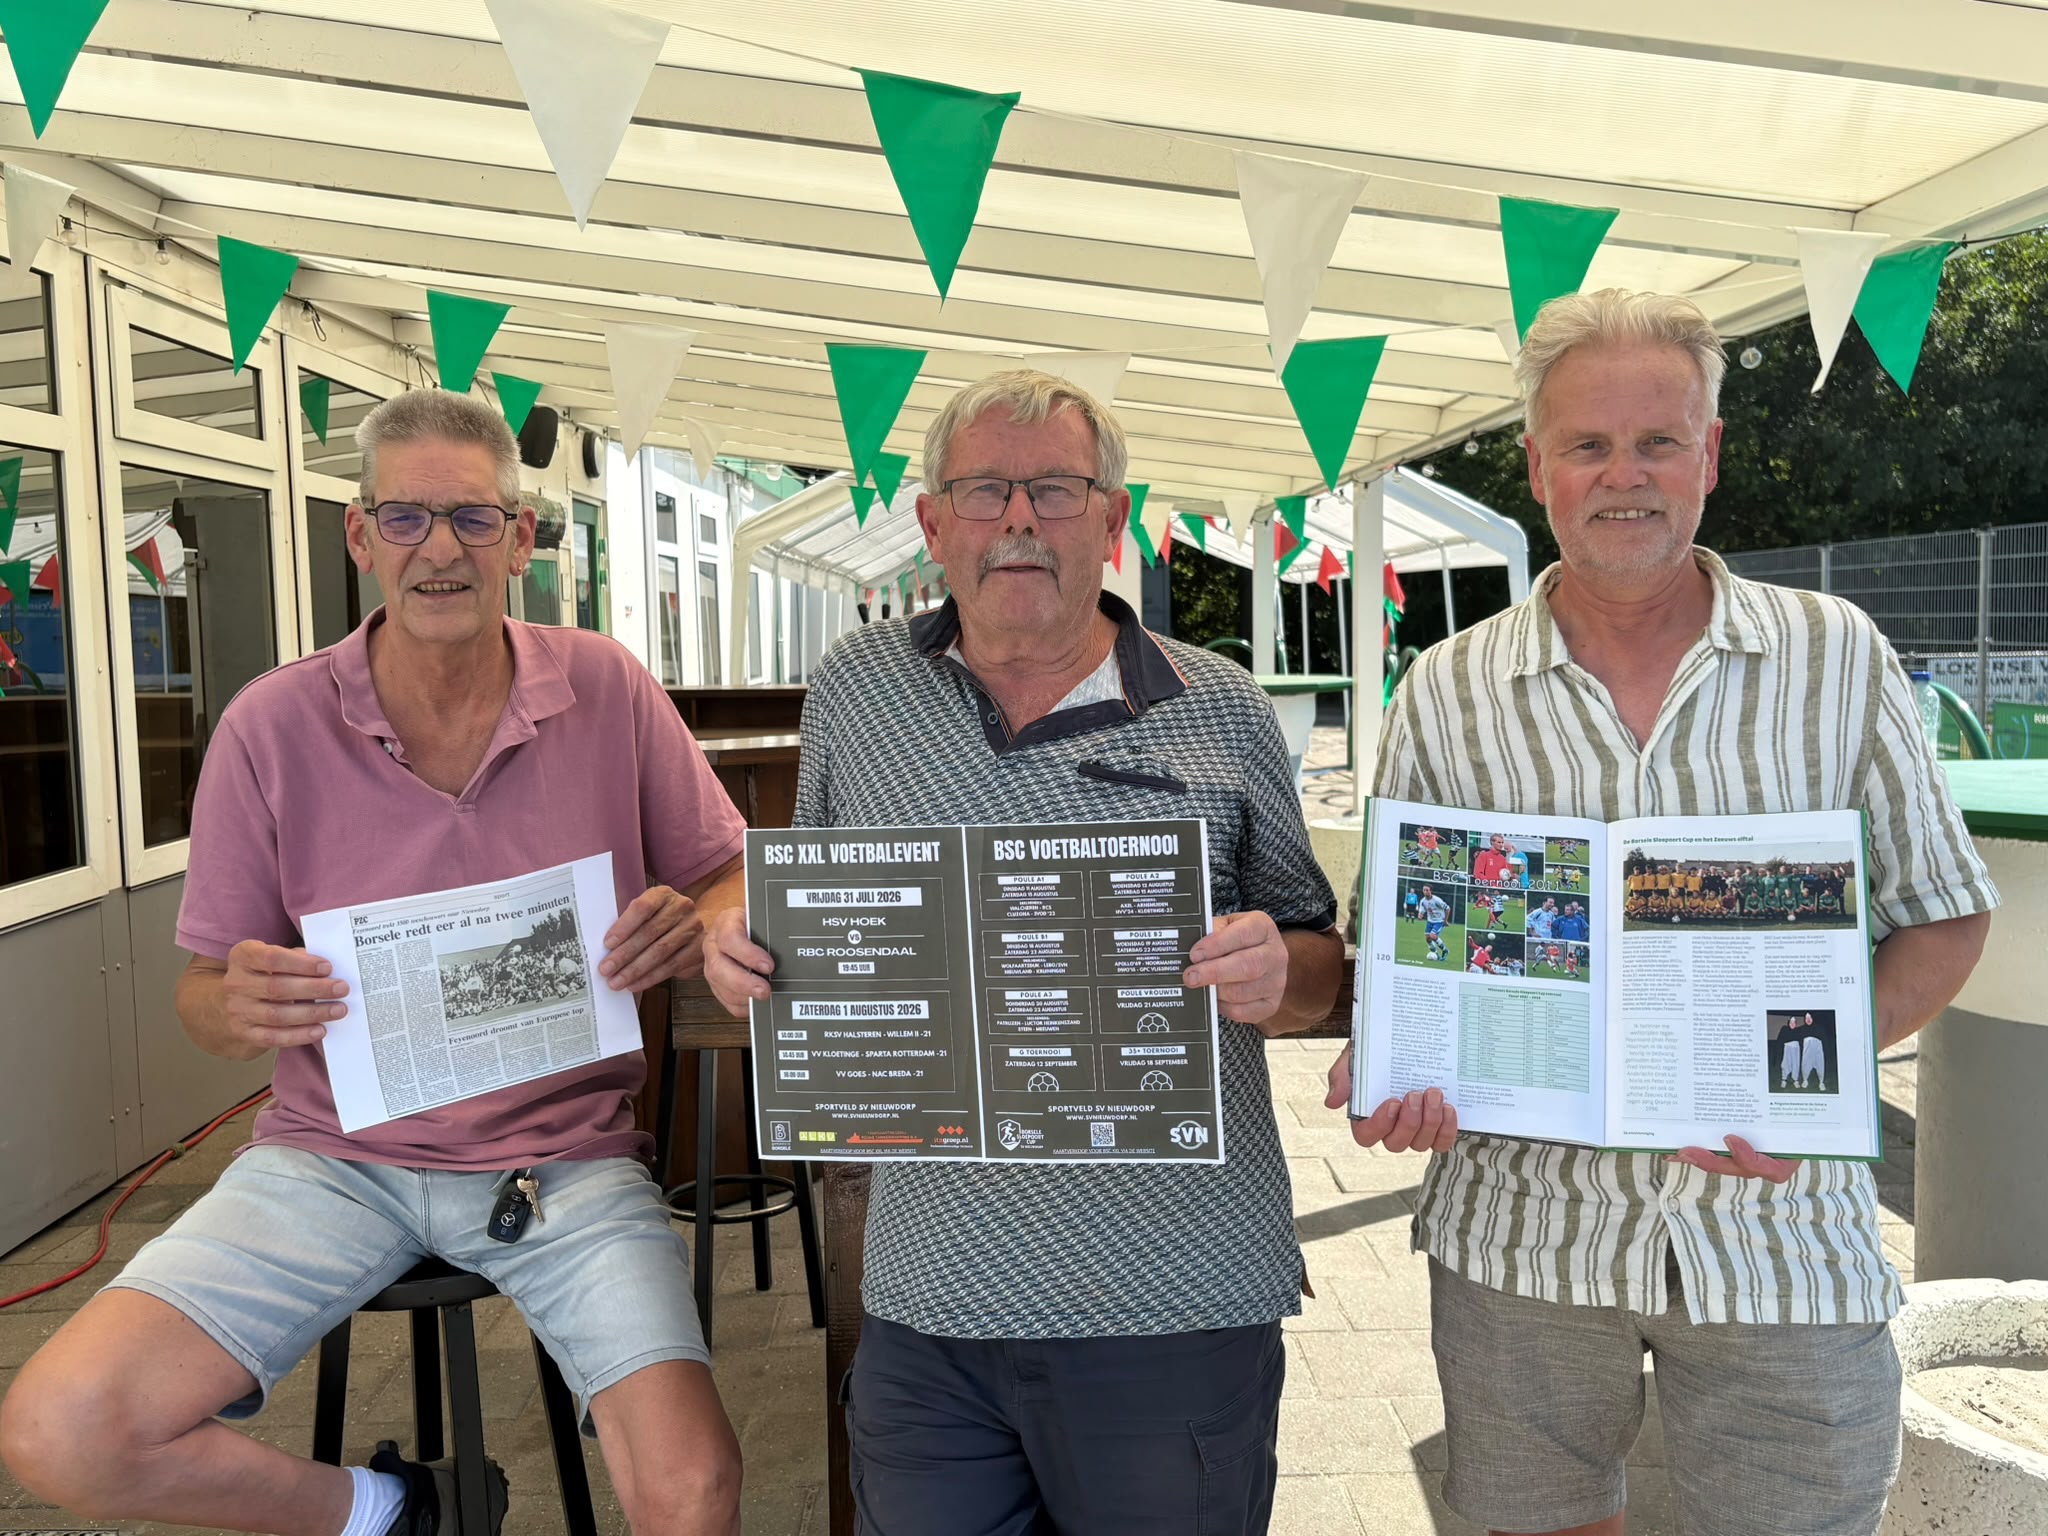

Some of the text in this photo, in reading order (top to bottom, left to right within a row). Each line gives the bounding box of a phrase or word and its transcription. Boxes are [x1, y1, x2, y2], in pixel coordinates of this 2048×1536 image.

[1934, 661, 2031, 674] LOKRSE
[765, 842, 940, 864] BSC XXL VOETBALEVENT
[994, 834, 1179, 860] BSC VOETBALTOERNOOI
[1433, 871, 1560, 891] BSC Toernooi 2011
[806, 891, 901, 904] VRIJDAG 31 JULI 2026
[354, 894, 569, 947] Borsele redt eer al na twee minuten
[354, 916, 369, 926] PZC
[822, 917, 886, 926] HSV HOEK
[797, 947, 917, 956] RBC ROOSENDAAL
[1376, 953, 1390, 961] 120
[799, 1004, 922, 1016] ZATERDAG 1 AUGUSTUS 2026
[449, 1029, 488, 1045] Feyenoord
[490, 1023, 518, 1036] droomt
[536, 1011, 570, 1023] Europese
[572, 1006, 584, 1015] top
[1048, 1105, 1093, 1113] SPORTVELD
[1170, 1127, 1208, 1144] SVN
